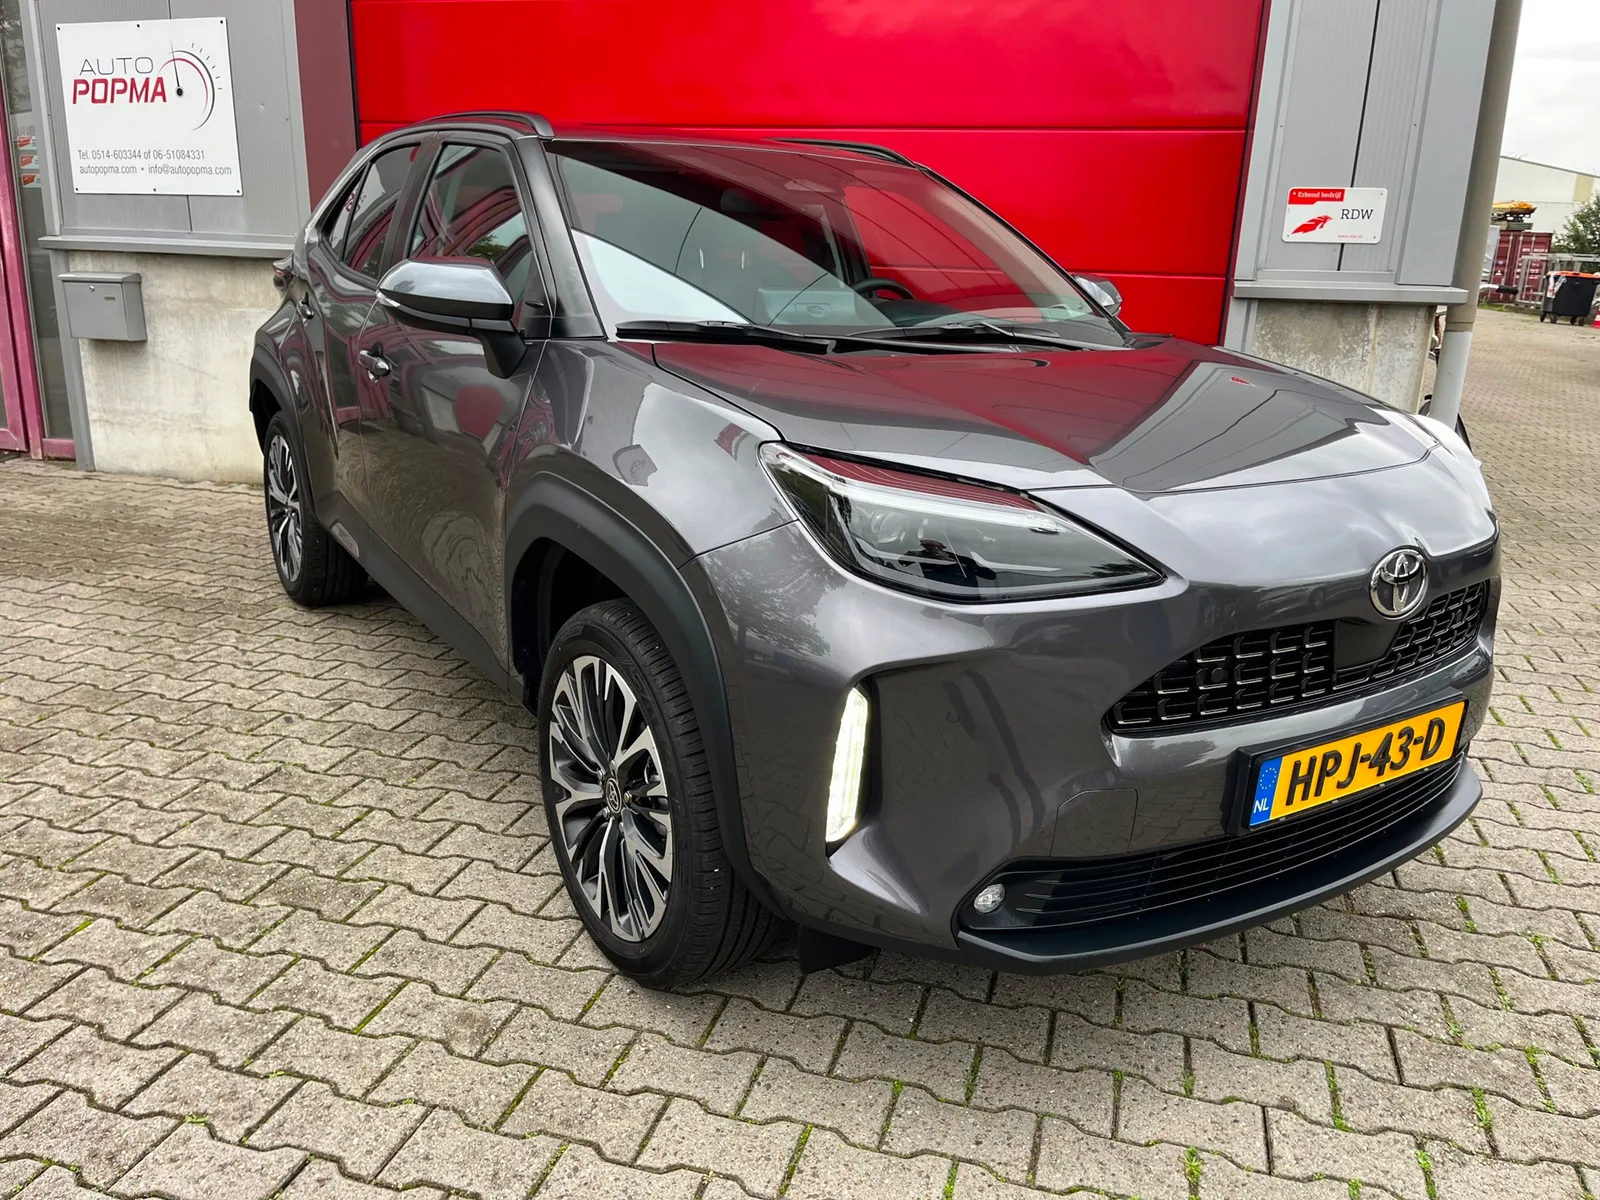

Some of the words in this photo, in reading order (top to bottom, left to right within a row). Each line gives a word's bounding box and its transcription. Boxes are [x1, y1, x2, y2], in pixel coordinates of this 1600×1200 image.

[79, 56, 154, 76] AUTO
[72, 76, 167, 105] POPMA
[78, 149, 90, 160] Tel.
[91, 149, 142, 160] 0514-603344
[143, 149, 151, 160] of
[152, 149, 205, 160] 06-51084331
[79, 164, 138, 176] autopopma.com
[148, 164, 232, 176] info@autopopma.com
[1321, 191, 1342, 200] bedrijf
[1340, 208, 1374, 220] RDW
[1285, 716, 1446, 807] HPJ-43-D
[1253, 796, 1269, 814] NL
